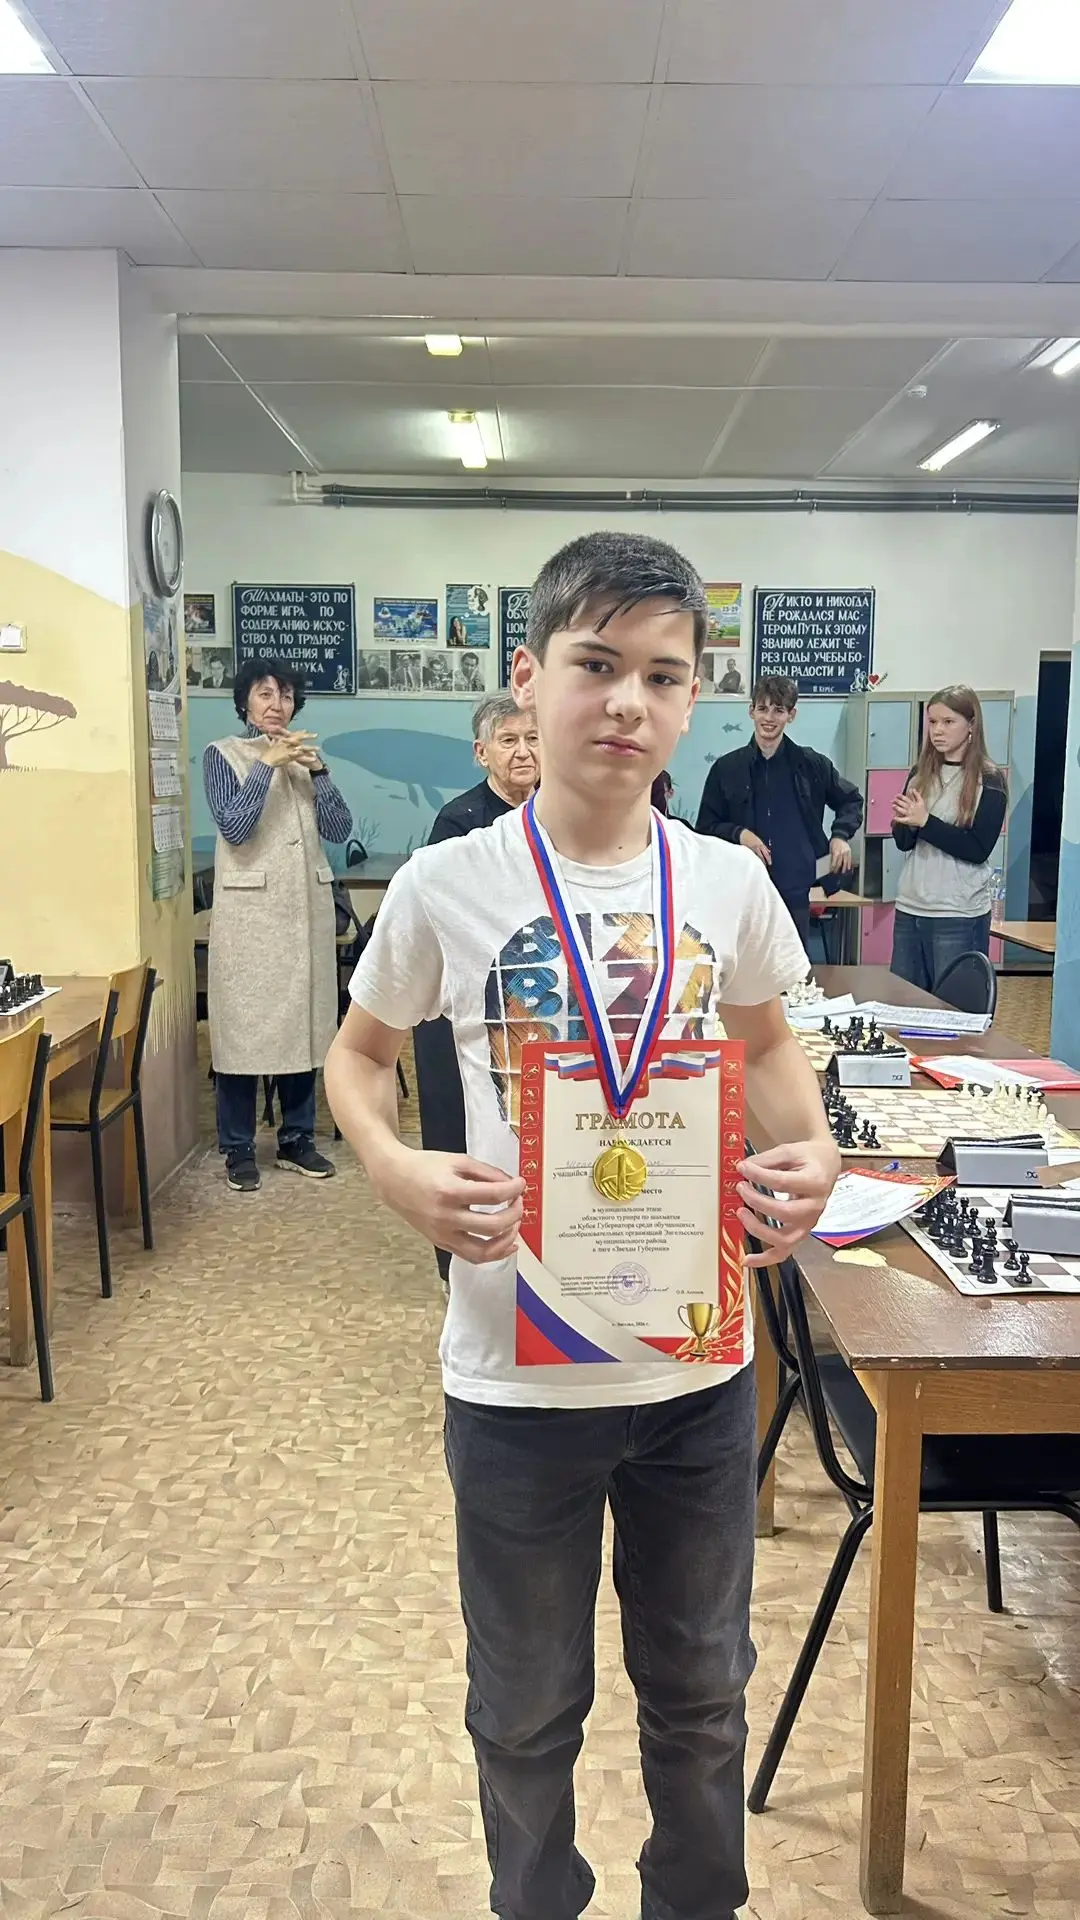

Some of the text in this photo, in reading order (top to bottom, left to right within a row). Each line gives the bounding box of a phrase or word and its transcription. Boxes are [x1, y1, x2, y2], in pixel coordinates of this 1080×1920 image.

[333, 592, 348, 603] ПО
[763, 593, 869, 611] НИКТО И НИКОГДА
[240, 605, 278, 617] ФОРМЕ
[320, 606, 334, 617] ПО
[762, 608, 864, 621] НЕ РОЖДАЛСЯ МАС-
[825, 625, 832, 635] К
[833, 624, 868, 635] ЭТОМУ
[280, 633, 294, 645] ПО
[297, 633, 344, 645] ТРУДНОС-
[761, 638, 860, 649] ЗВАНИЮ ЛЕЖИТ ЧЕ-
[242, 647, 254, 658] ТИ
[259, 647, 318, 659] ОВЛАДЕНИЯ
[761, 652, 780, 663] РЕЗ
[782, 652, 810, 663] ГОДЫ
[814, 652, 847, 663] УЧЕБЫ
[291, 661, 325, 673] НУКА
[791, 665, 834, 677] РАДОСТИ
[837, 666, 845, 676] И
[575, 1111, 686, 1131] ГРАМОТА
[599, 1138, 671, 1147] НАГЖДАЕТСЯ
